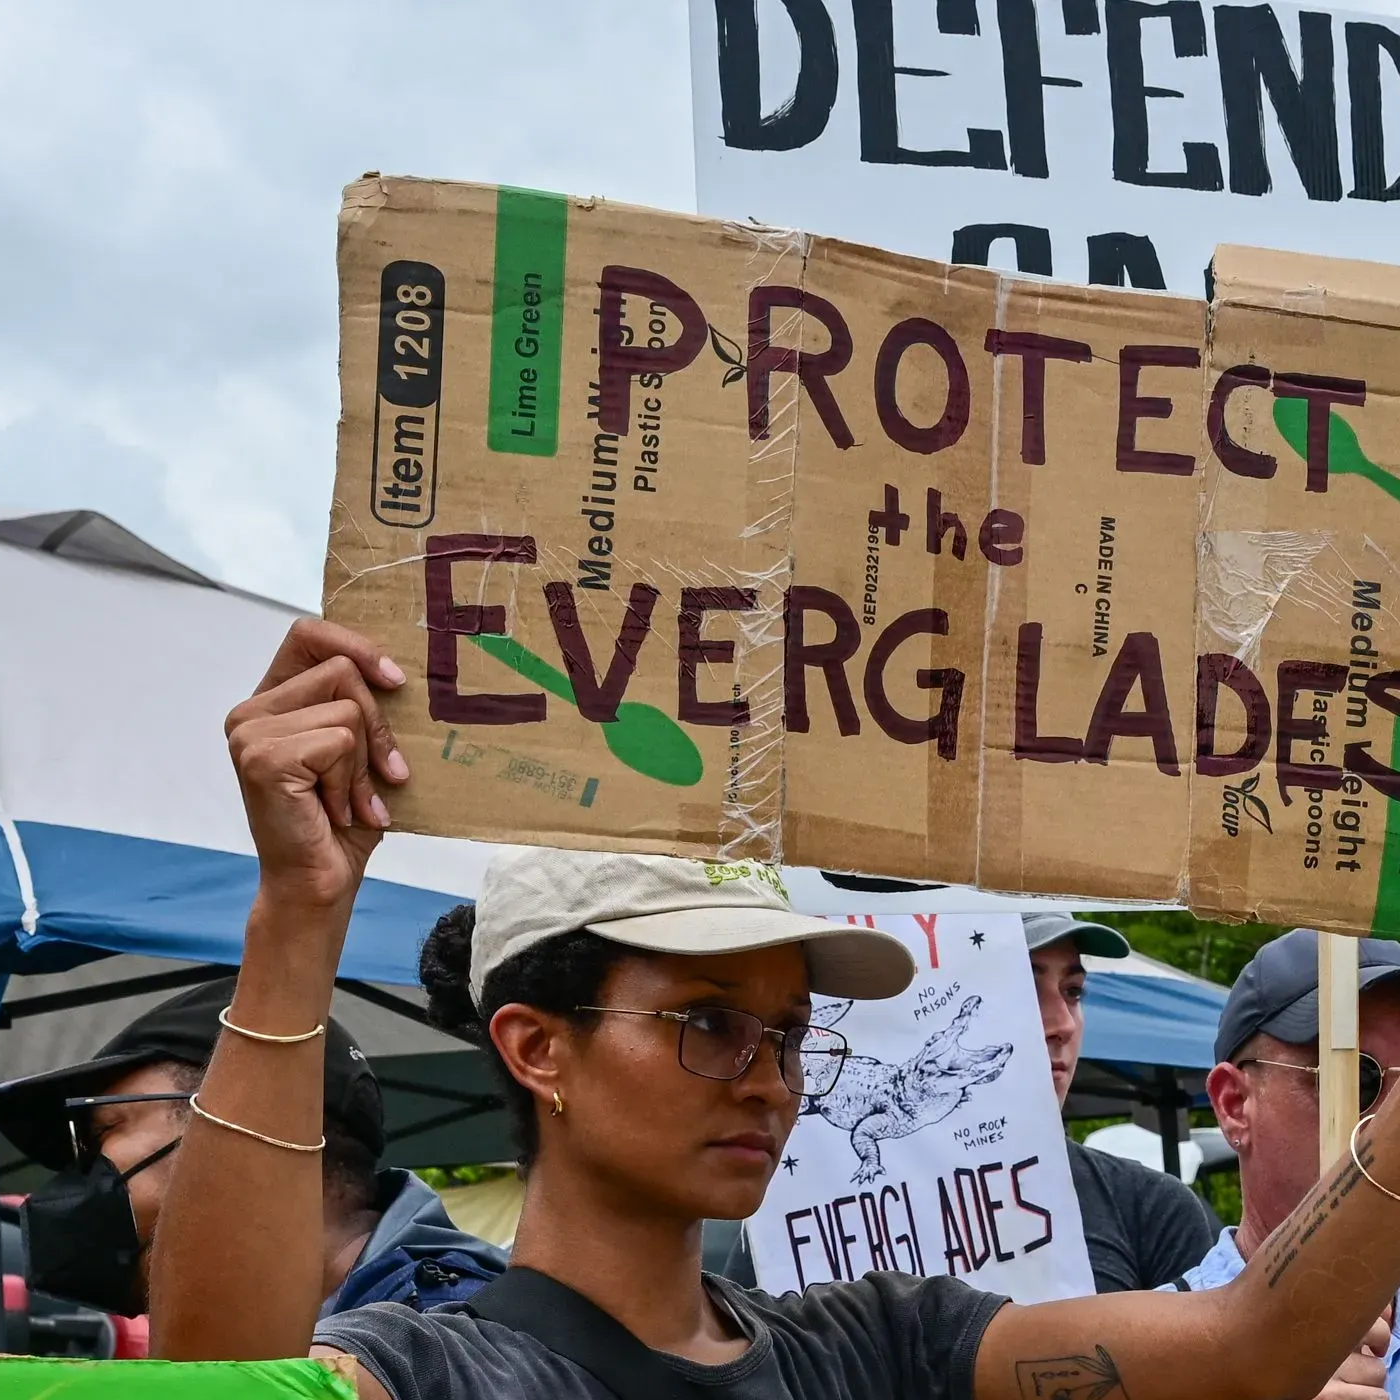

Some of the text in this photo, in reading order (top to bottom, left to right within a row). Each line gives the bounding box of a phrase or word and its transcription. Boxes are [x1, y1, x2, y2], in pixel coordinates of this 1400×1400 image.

[380, 284, 433, 513] Item 1208
[511, 272, 543, 437] Lime Green
[599, 264, 1367, 493] PROTECT
[633, 301, 668, 492] Plastic Soon
[577, 433, 619, 591] Medium
[868, 483, 1026, 566] the
[1074, 583, 1088, 595] C
[1092, 516, 1117, 658] MADE IN CHINA
[1345, 579, 1382, 729] Medium
[1303, 690, 1334, 870] lastic poons
[913, 981, 961, 1021] PRISONS
[918, 986, 936, 1004] NO
[953, 1116, 1008, 1141] NO ROCK
[963, 1131, 1004, 1151] MINES
